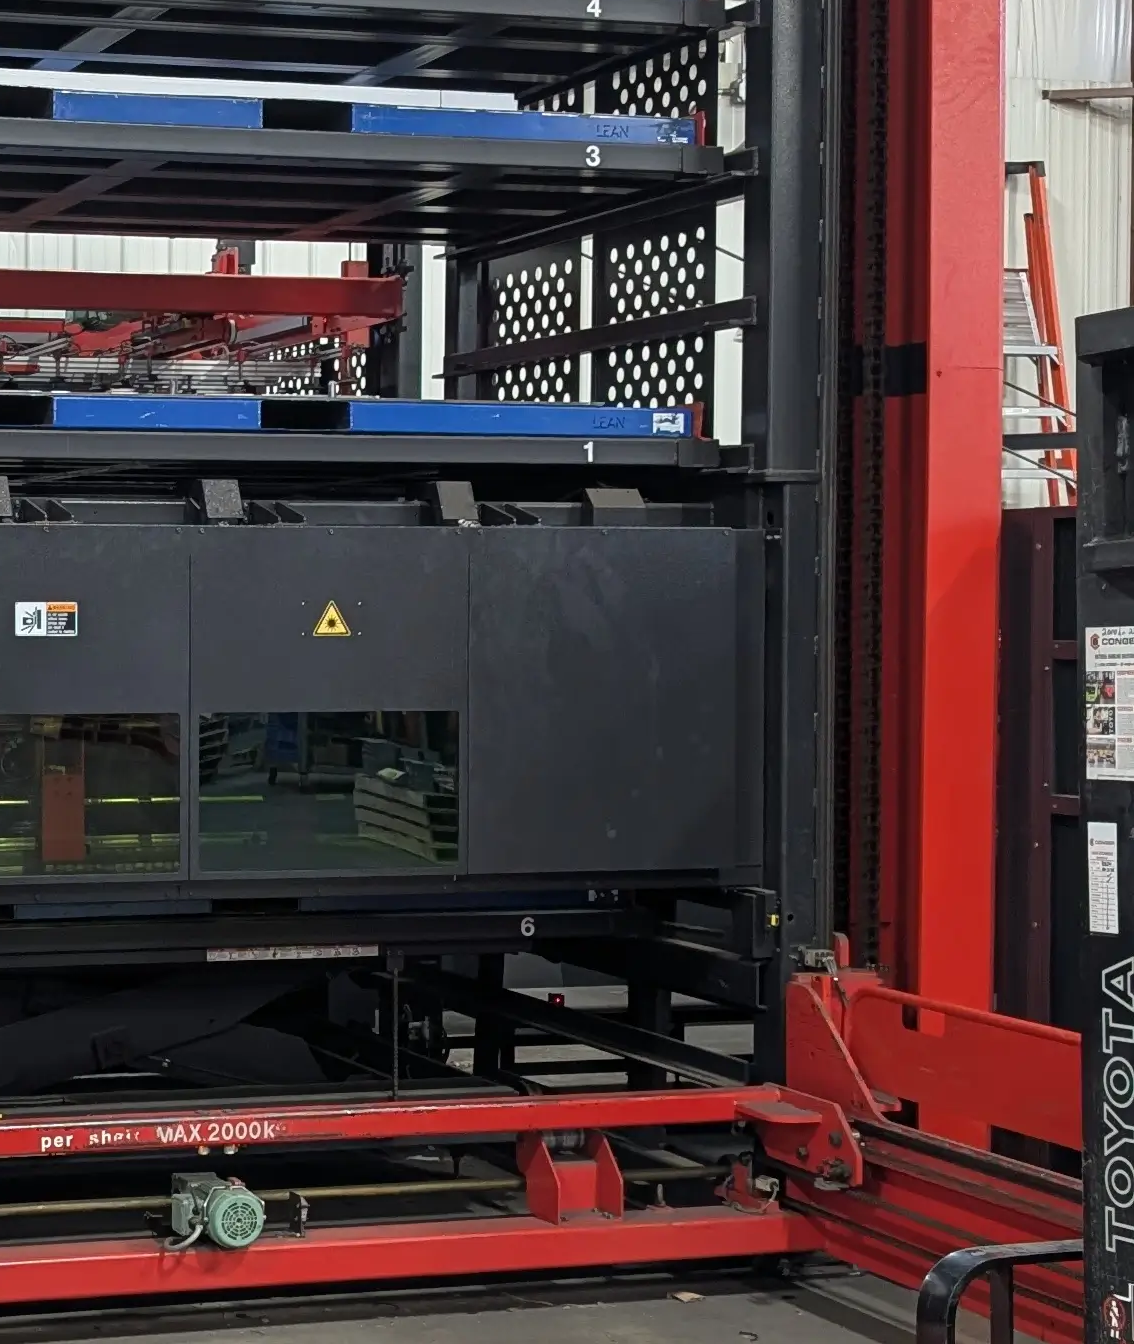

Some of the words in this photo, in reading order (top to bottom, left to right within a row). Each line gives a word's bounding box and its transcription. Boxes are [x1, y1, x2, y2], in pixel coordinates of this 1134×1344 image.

[596, 124, 629, 138] LEAN
[585, 146, 601, 167] 3
[592, 416, 625, 429] LEAN
[583, 441, 594, 464] 1
[520, 916, 535, 937] 6
[1102, 956, 1134, 1253] TOYOTA
[41, 1132, 73, 1151] per
